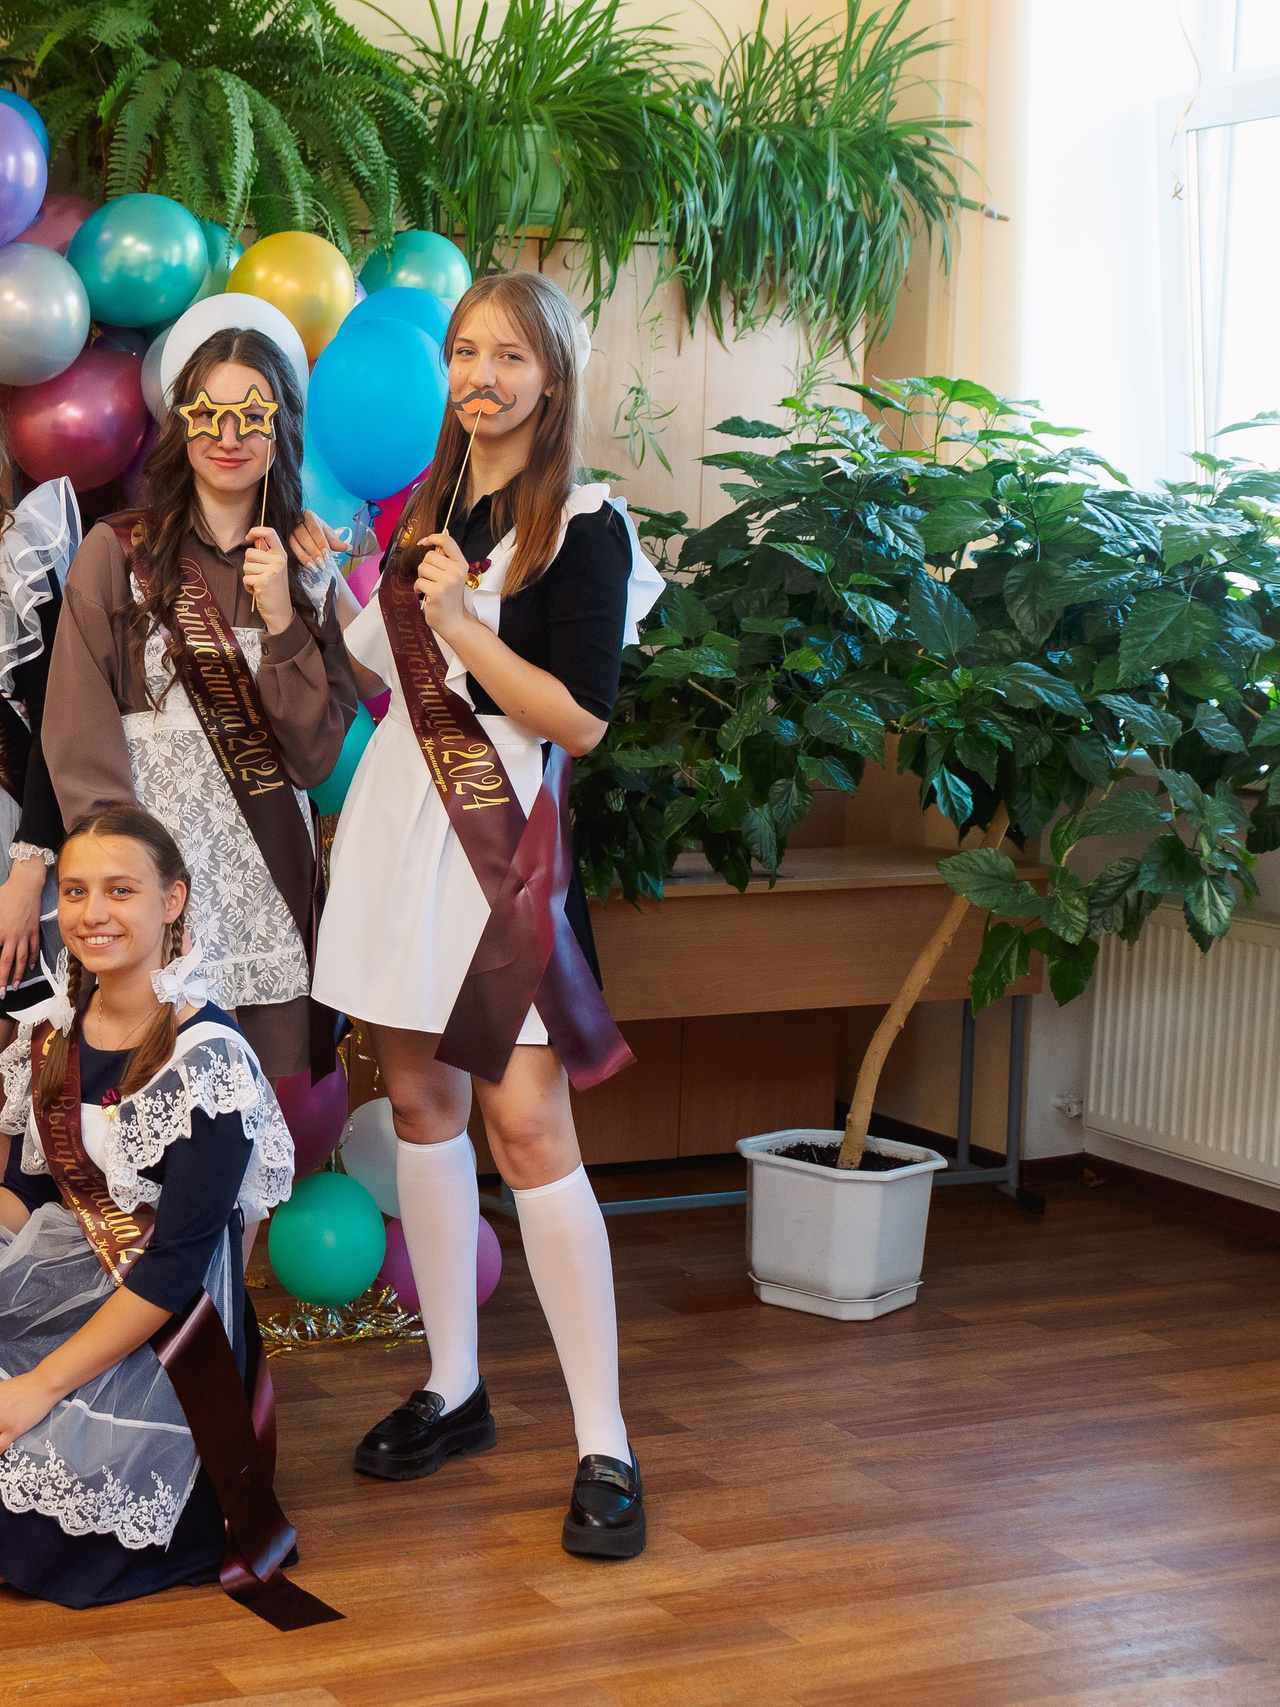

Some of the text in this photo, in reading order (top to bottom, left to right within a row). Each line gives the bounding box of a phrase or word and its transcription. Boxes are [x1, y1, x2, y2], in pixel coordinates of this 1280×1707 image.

[174, 557, 285, 796] Выпускница 2024
[390, 573, 510, 811] Выпускница 2024
[207, 724, 236, 780] Кронштадт
[421, 736, 448, 793] Кронштадт
[77, 1206, 96, 1232] №422
